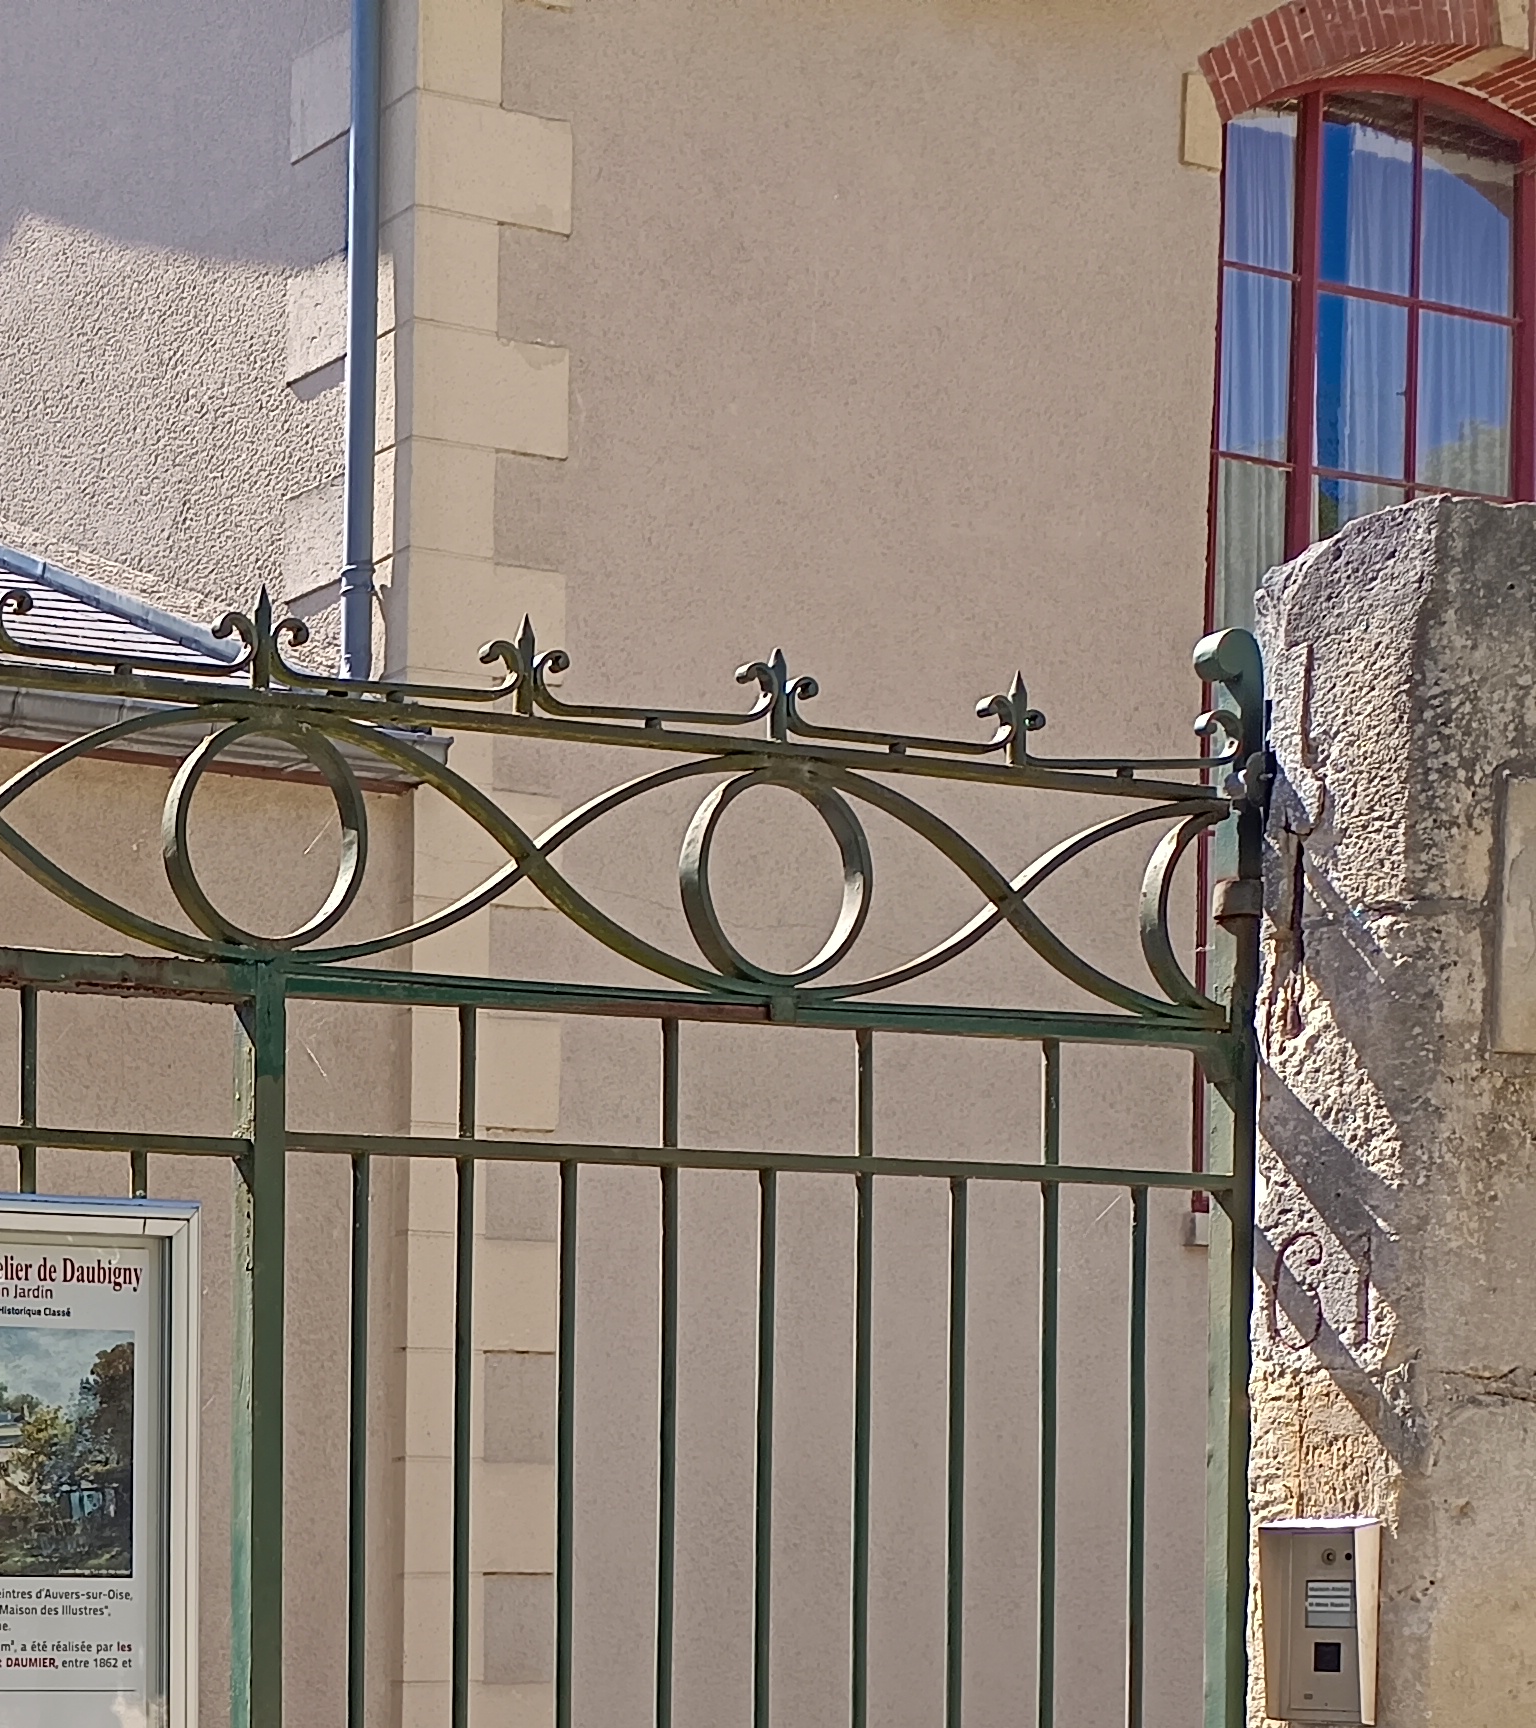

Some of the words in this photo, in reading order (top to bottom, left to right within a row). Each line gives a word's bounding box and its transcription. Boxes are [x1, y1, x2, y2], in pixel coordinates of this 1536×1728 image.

[38, 1257, 57, 1282] de
[62, 1257, 143, 1292] Daubigny
[13, 1284, 53, 1299] Jardin
[43, 1307, 71, 1317] Classé
[35, 1588, 133, 1601] d'Auvers-sur-Oise,
[40, 1605, 59, 1616] des
[20, 1644, 27, 1652] a
[30, 1641, 48, 1652] été
[51, 1641, 93, 1652] réalisée
[96, 1643, 114, 1654] par
[116, 1641, 132, 1652] les
[6, 1657, 59, 1670] DAUMIER,
[61, 1658, 90, 1668] entre
[93, 1658, 118, 1668] 1862
[122, 1658, 132, 1668] et
